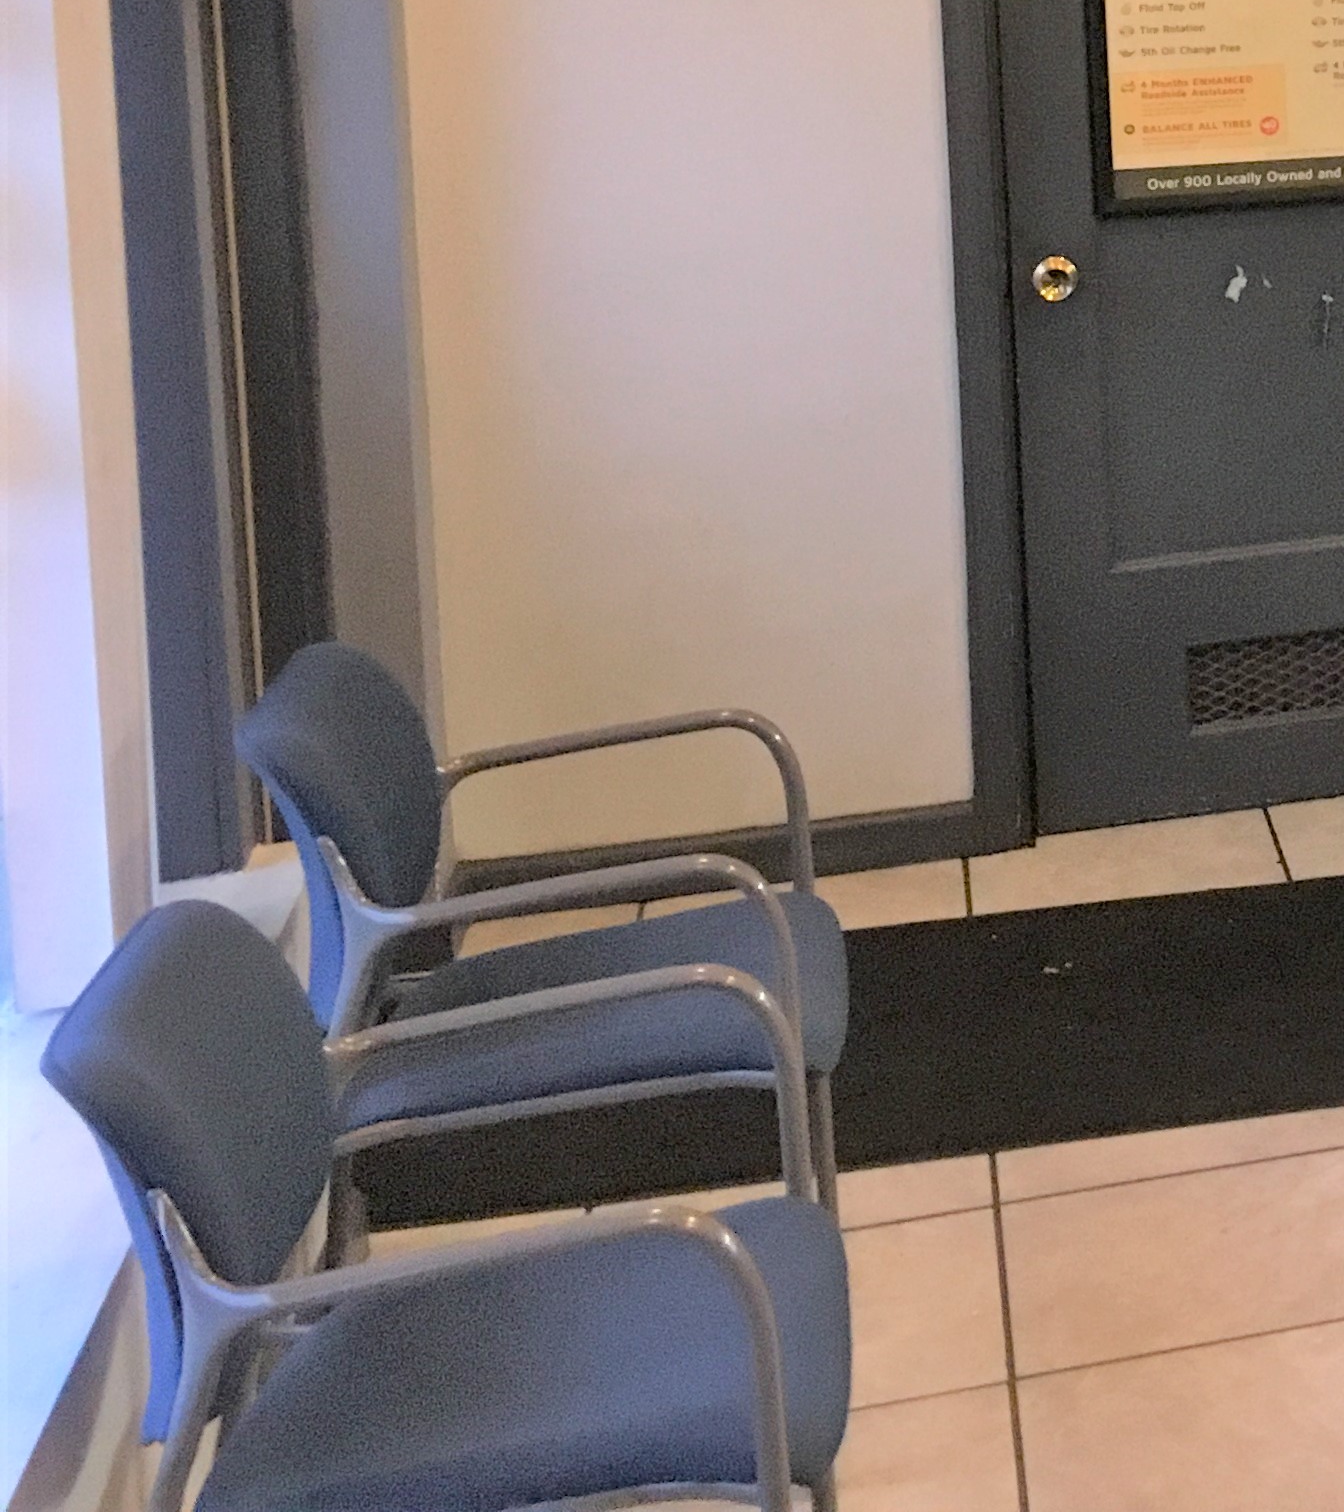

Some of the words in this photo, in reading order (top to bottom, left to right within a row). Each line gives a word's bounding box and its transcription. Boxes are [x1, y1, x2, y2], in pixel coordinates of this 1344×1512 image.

[1167, 2, 1185, 13] Top
[1189, 1, 1206, 11] Off
[1192, 74, 1254, 86] ENHANCED
[1142, 123, 1194, 134] BALANCE
[1198, 121, 1218, 131] ALL
[1222, 119, 1252, 129] TIRES
[1148, 178, 1179, 192] Over
[1183, 175, 1211, 188] 900
[1217, 173, 1261, 188] Locally
[1266, 169, 1312, 183] Owned
[1318, 167, 1341, 180] and
